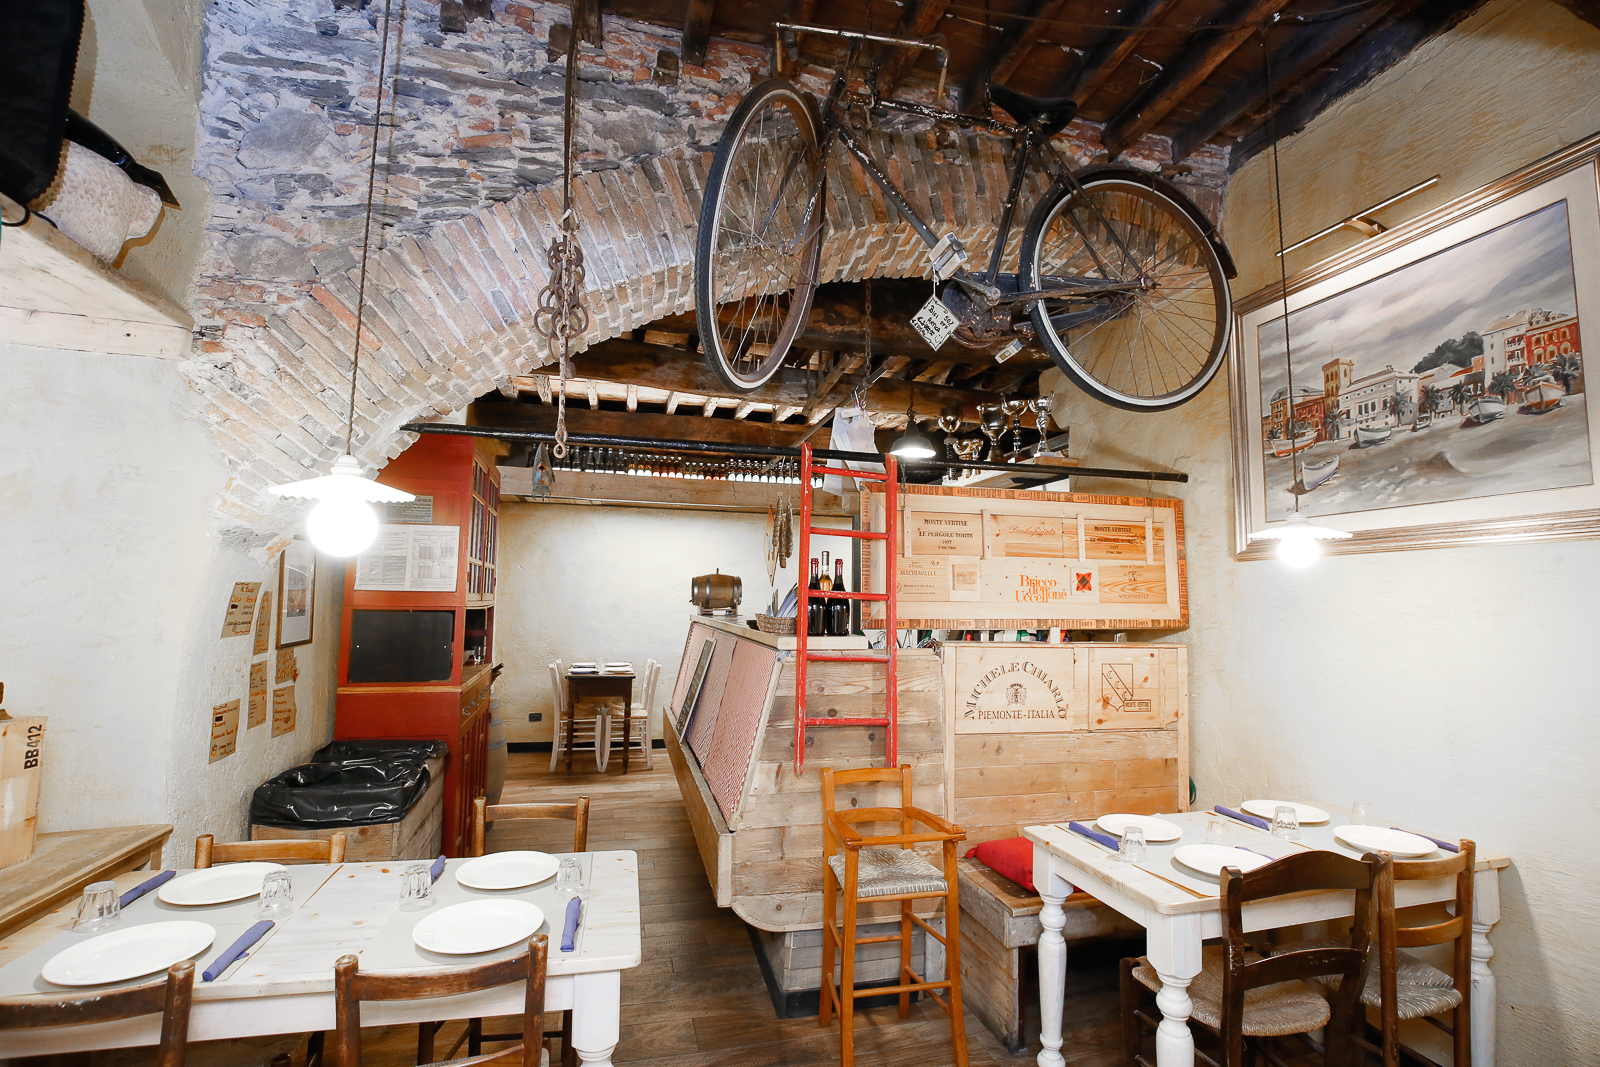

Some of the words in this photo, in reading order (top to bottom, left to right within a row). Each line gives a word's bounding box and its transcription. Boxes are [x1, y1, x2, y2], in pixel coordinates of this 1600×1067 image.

[1014, 588, 1068, 604] Uccellone
[1019, 574, 1057, 587] Bricco
[964, 662, 1020, 720] MICHELE
[1022, 661, 1068, 719] CHIARLO
[24, 724, 43, 770] BB412
